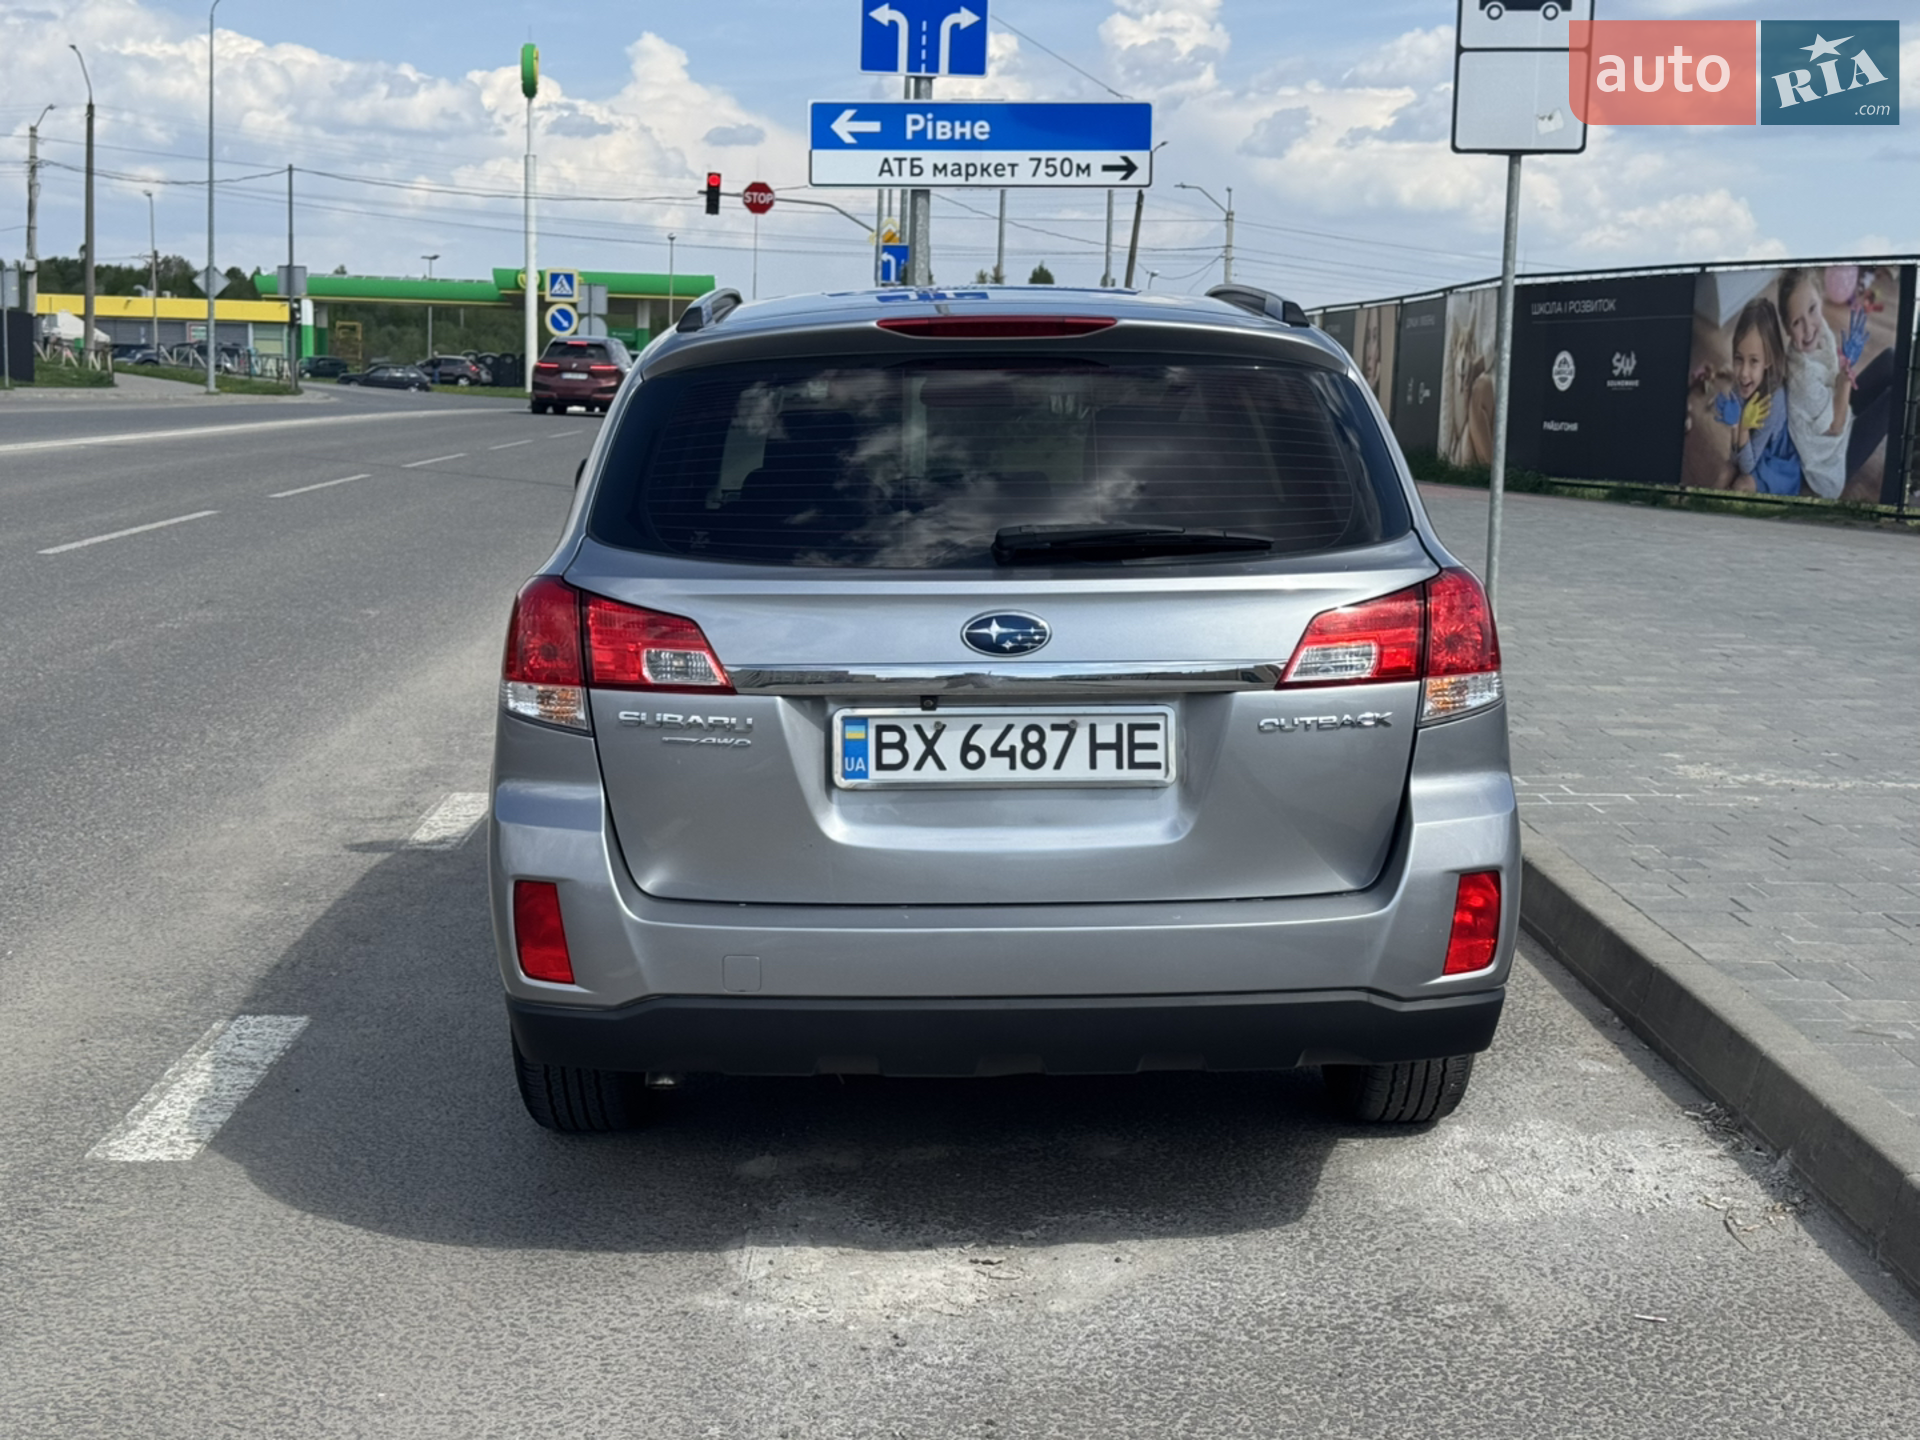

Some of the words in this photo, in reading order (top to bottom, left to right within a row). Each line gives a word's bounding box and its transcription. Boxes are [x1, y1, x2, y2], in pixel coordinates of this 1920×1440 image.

[905, 113, 991, 141] Рівне
[878, 157, 924, 178] АТБ
[932, 161, 1020, 182] маркет
[1028, 157, 1092, 178] 750м
[744, 191, 774, 204] STOP
[1531, 301, 1563, 315] ШКОЛА
[1569, 298, 1617, 314] РОЗВИТОК
[618, 711, 753, 733] SUBARU
[1258, 712, 1393, 733] OUTBACK
[875, 723, 947, 771] BX
[959, 723, 1078, 771] 6487
[1089, 722, 1162, 770] HE
[844, 757, 867, 772] UA
